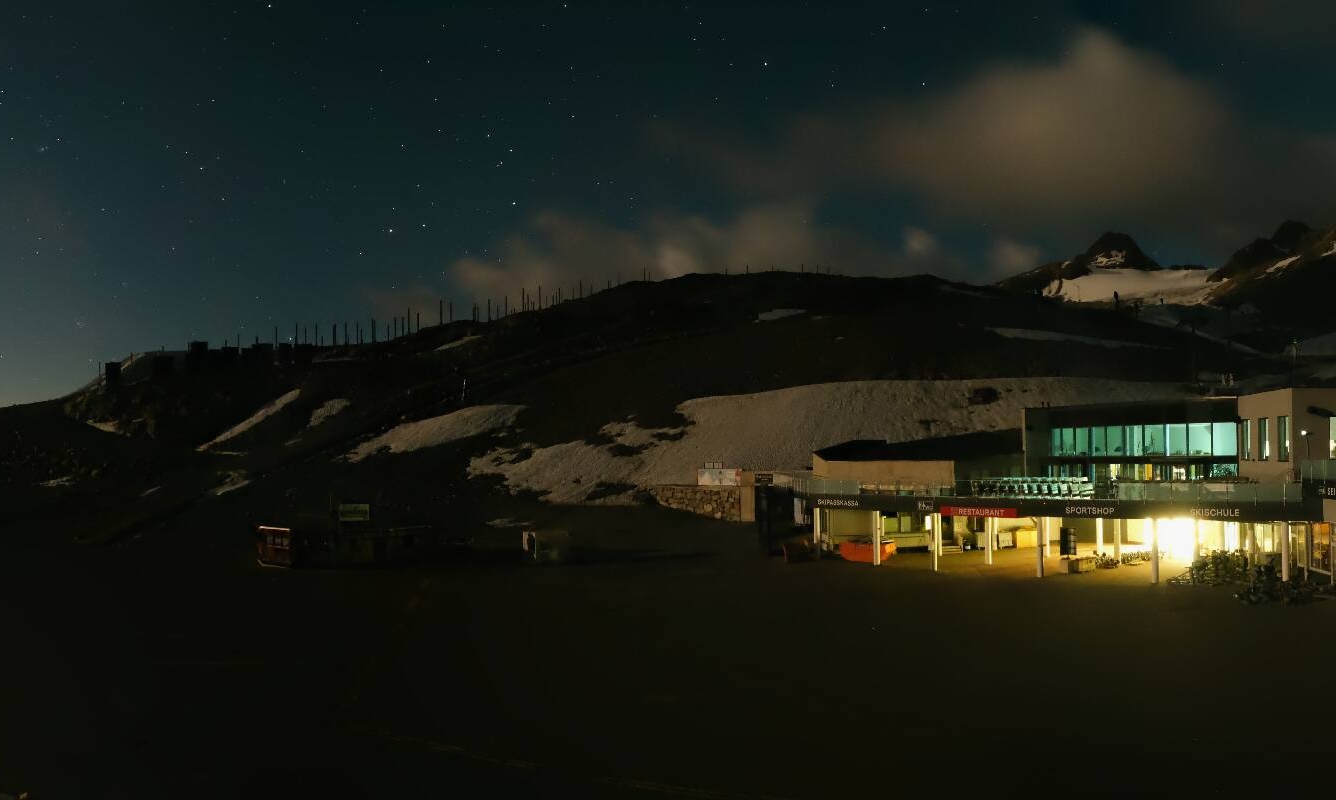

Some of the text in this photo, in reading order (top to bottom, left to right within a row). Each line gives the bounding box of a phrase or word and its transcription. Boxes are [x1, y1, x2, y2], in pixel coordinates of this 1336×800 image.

[958, 507, 1005, 516] RESTAURANT
[1065, 506, 1115, 515] SPORTSHOP
[1190, 508, 1240, 517] SKISCHULE
